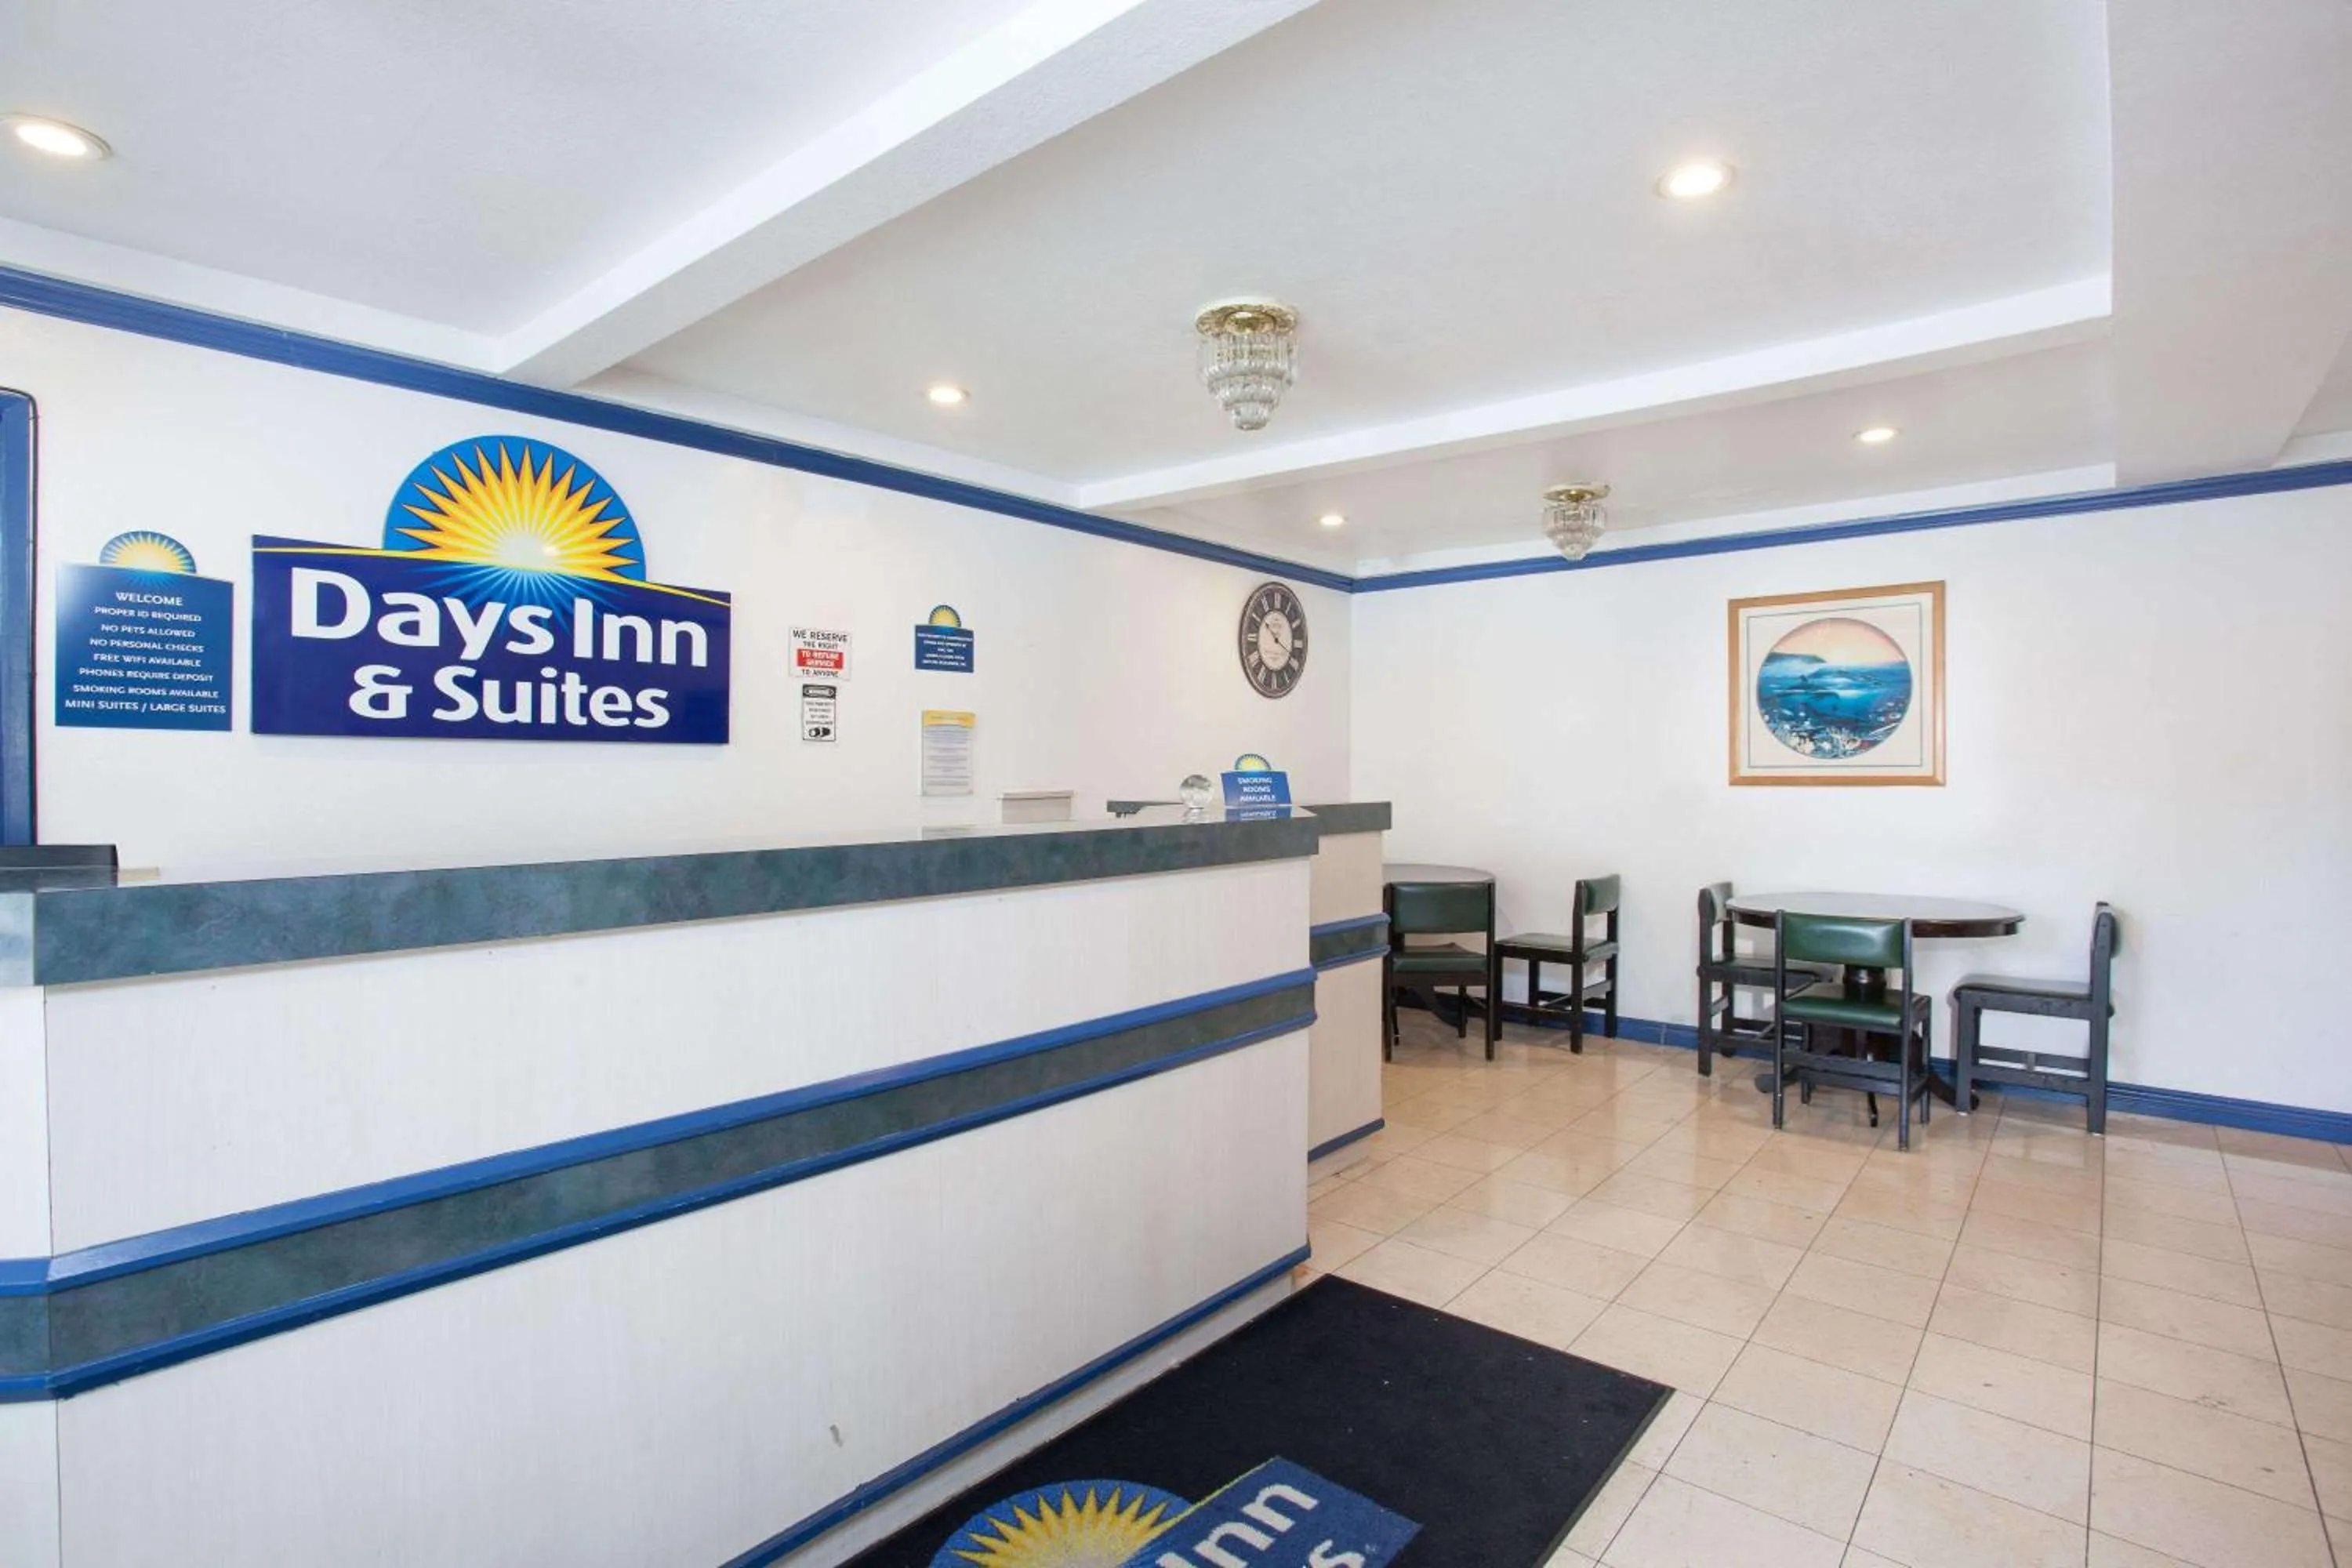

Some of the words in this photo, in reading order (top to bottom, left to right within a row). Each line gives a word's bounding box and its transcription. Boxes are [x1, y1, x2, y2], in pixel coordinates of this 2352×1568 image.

[115, 591, 183, 607] WELCOME
[94, 605, 136, 618] PROPER
[136, 610, 150, 619] ID
[151, 611, 202, 622] REQUIRED
[290, 566, 555, 661] Days
[572, 597, 708, 668] Inn
[100, 623, 118, 633] NO
[121, 625, 145, 634] PETS
[147, 628, 196, 637] ALLOWED
[793, 630, 807, 639] WE
[811, 630, 848, 643] RESERVE
[89, 637, 108, 647] NO
[110, 639, 163, 650] PERSONAL
[165, 643, 205, 653] CHECKS
[818, 641, 838, 650] RIGHT
[93, 653, 120, 662] FREE
[148, 657, 201, 667] AVAILABLE
[78, 667, 125, 677] PHONES
[126, 670, 170, 681] REQUIRE
[172, 672, 214, 683] DEPOSIT
[813, 670, 839, 678] ANYONE
[73, 684, 126, 695] SMOKING
[128, 687, 167, 696] ROOMS
[169, 689, 219, 699] AVAILABLE
[348, 663, 414, 720] &
[432, 665, 670, 728] Suites
[65, 699, 95, 709] MINI
[97, 700, 140, 710] SUITES
[150, 702, 186, 713] LARGE
[188, 704, 227, 714] SUITES
